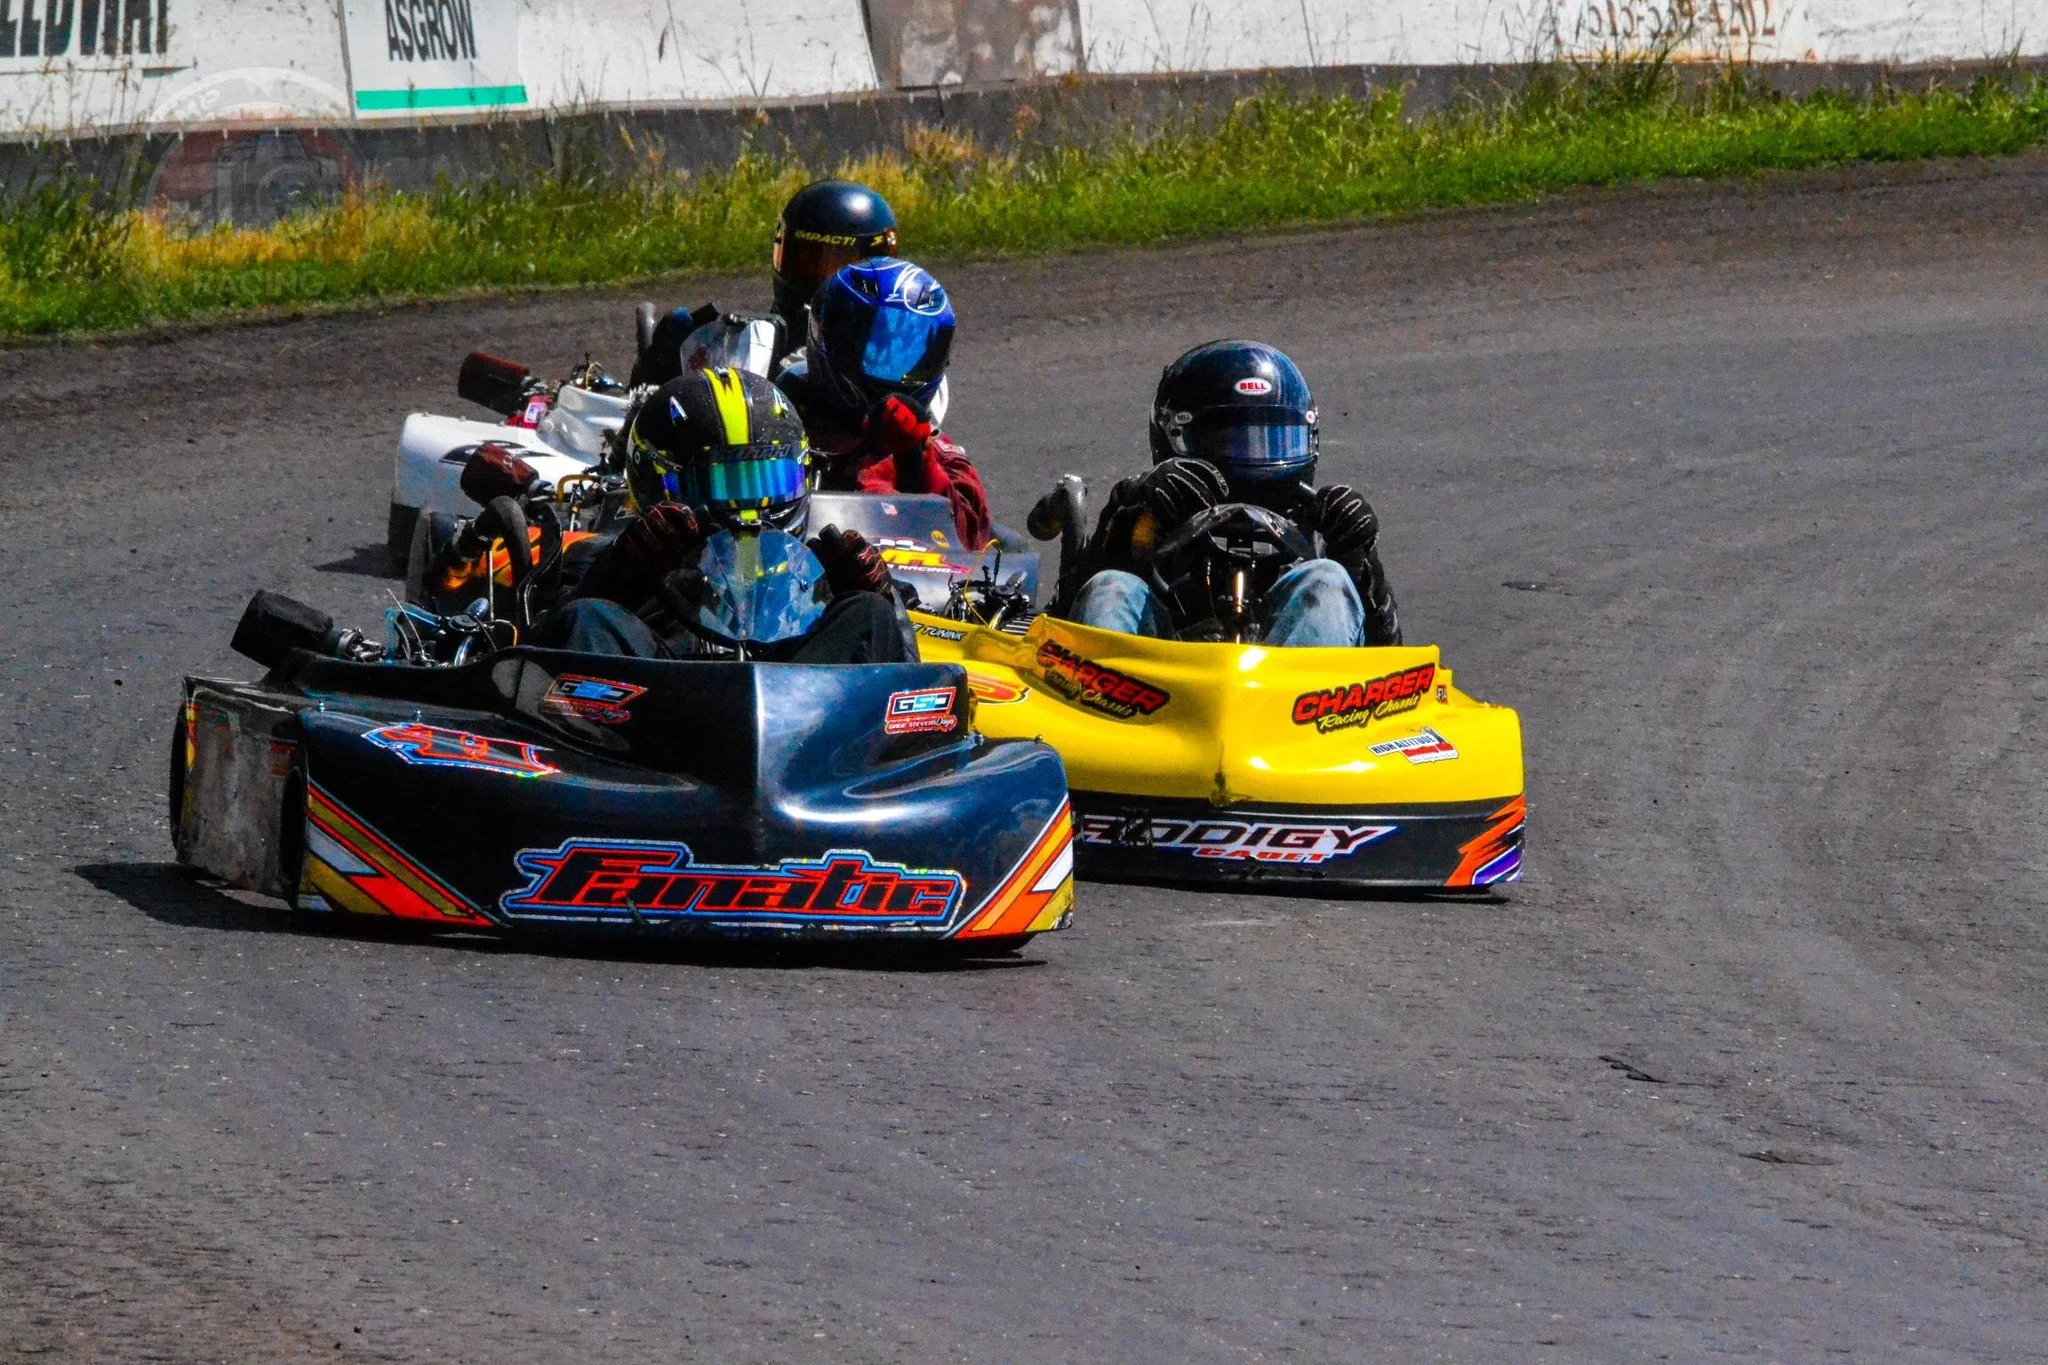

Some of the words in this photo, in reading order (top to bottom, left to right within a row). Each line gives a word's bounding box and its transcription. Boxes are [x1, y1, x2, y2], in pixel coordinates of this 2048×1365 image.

[385, 0, 476, 62] ASGROW
[1240, 382, 1266, 390] BELL
[1293, 664, 1434, 723] CHARGER
[1318, 708, 1370, 730] Racing
[1374, 694, 1419, 716] Chassis
[1083, 814, 1397, 853] RODIGY
[1196, 847, 1330, 862] CADET
[516, 844, 961, 920] Fanatic
